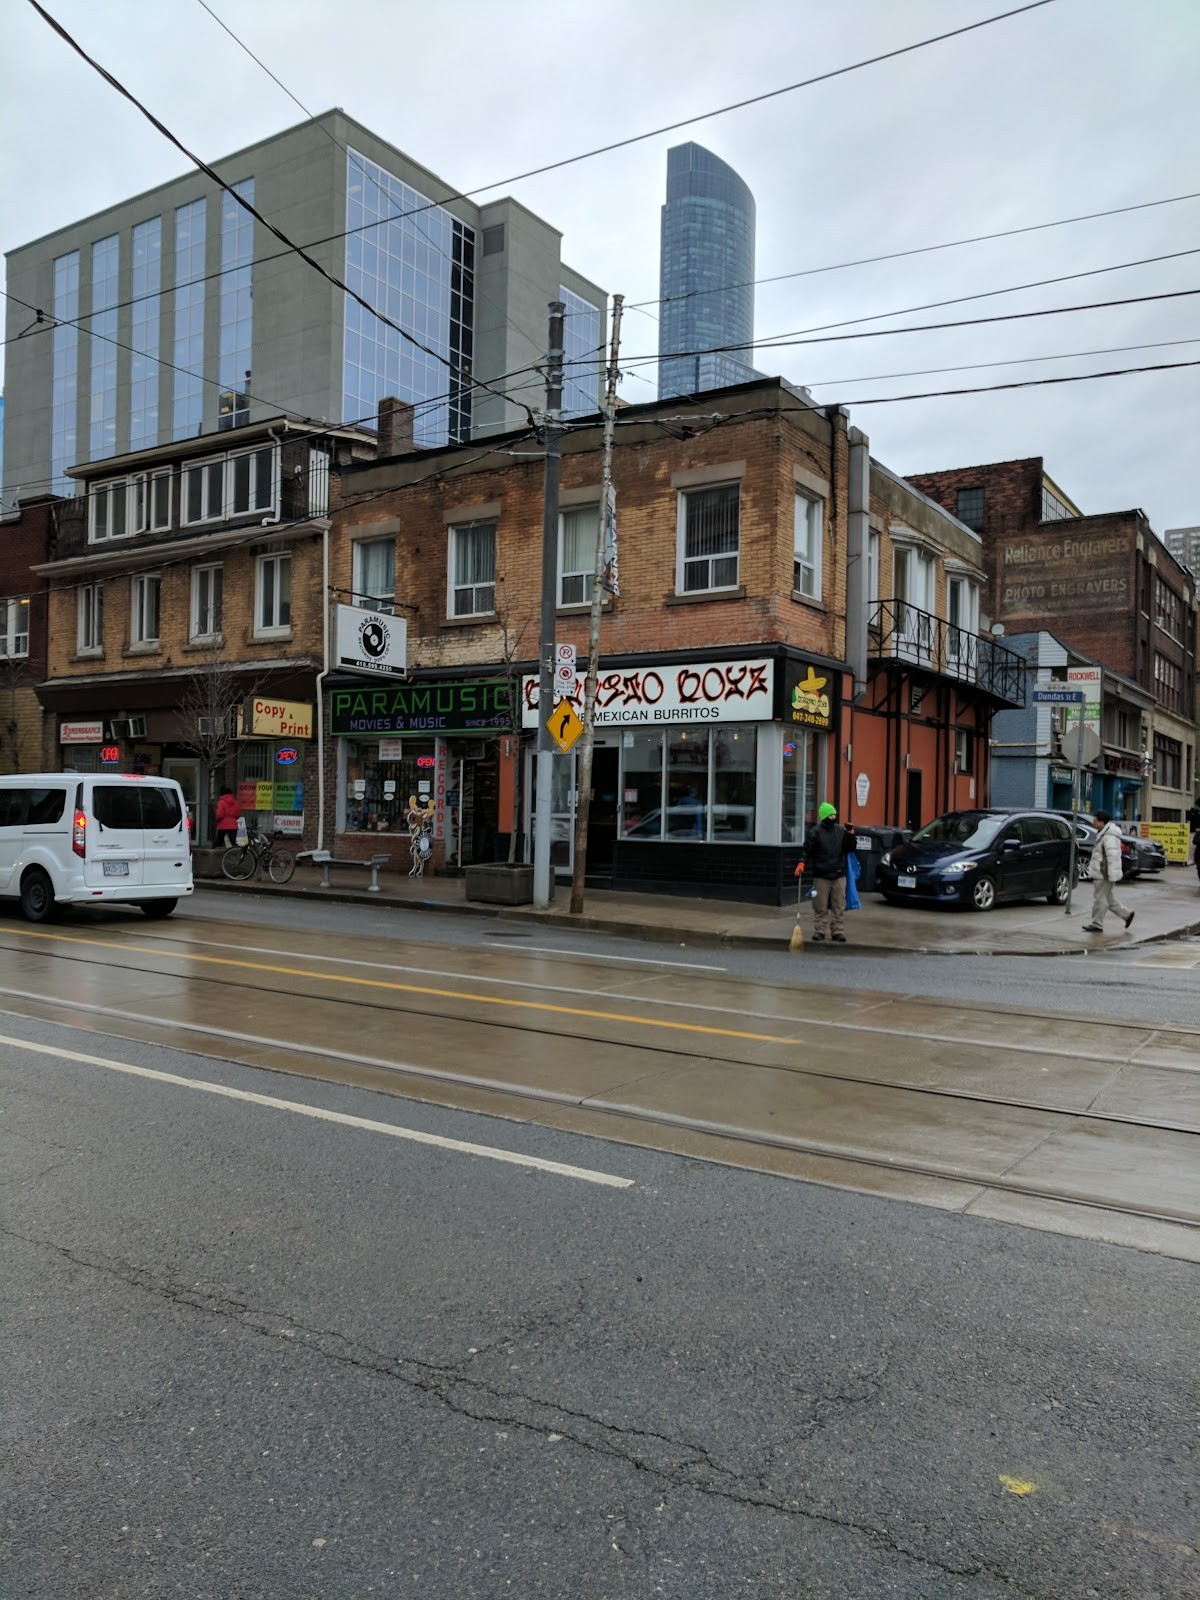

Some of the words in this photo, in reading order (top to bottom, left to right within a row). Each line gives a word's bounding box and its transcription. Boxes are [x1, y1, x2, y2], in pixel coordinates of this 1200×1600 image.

[1005, 544, 1060, 563] Reliance
[1005, 585, 1045, 601] PHOTO
[1051, 578, 1127, 597] ENGRAVERS
[358, 616, 391, 640] PARAMUSIC
[1068, 671, 1100, 681] ROCKWELL
[524, 671, 664, 711] BITO
[677, 664, 768, 704] BOYZ
[336, 686, 511, 717] PARAMUSIC
[1037, 692, 1065, 701] Dundas
[1072, 692, 1077, 701] E
[255, 701, 286, 719] Copy
[593, 710, 648, 722] MEXICAN
[654, 707, 720, 721] BURRITOS
[280, 721, 309, 736] Print
[350, 718, 391, 730] MOVIES
[395, 716, 404, 730] &
[409, 717, 446, 729] MUSIC
[465, 719, 486, 727] SINCE
[490, 718, 511, 727] 1995
[102, 747, 119, 761] OPEN
[279, 751, 298, 760] OPEN
[417, 757, 436, 767] OPEN
[436, 746, 446, 837] RECORDS
[274, 817, 301, 827] Canon
